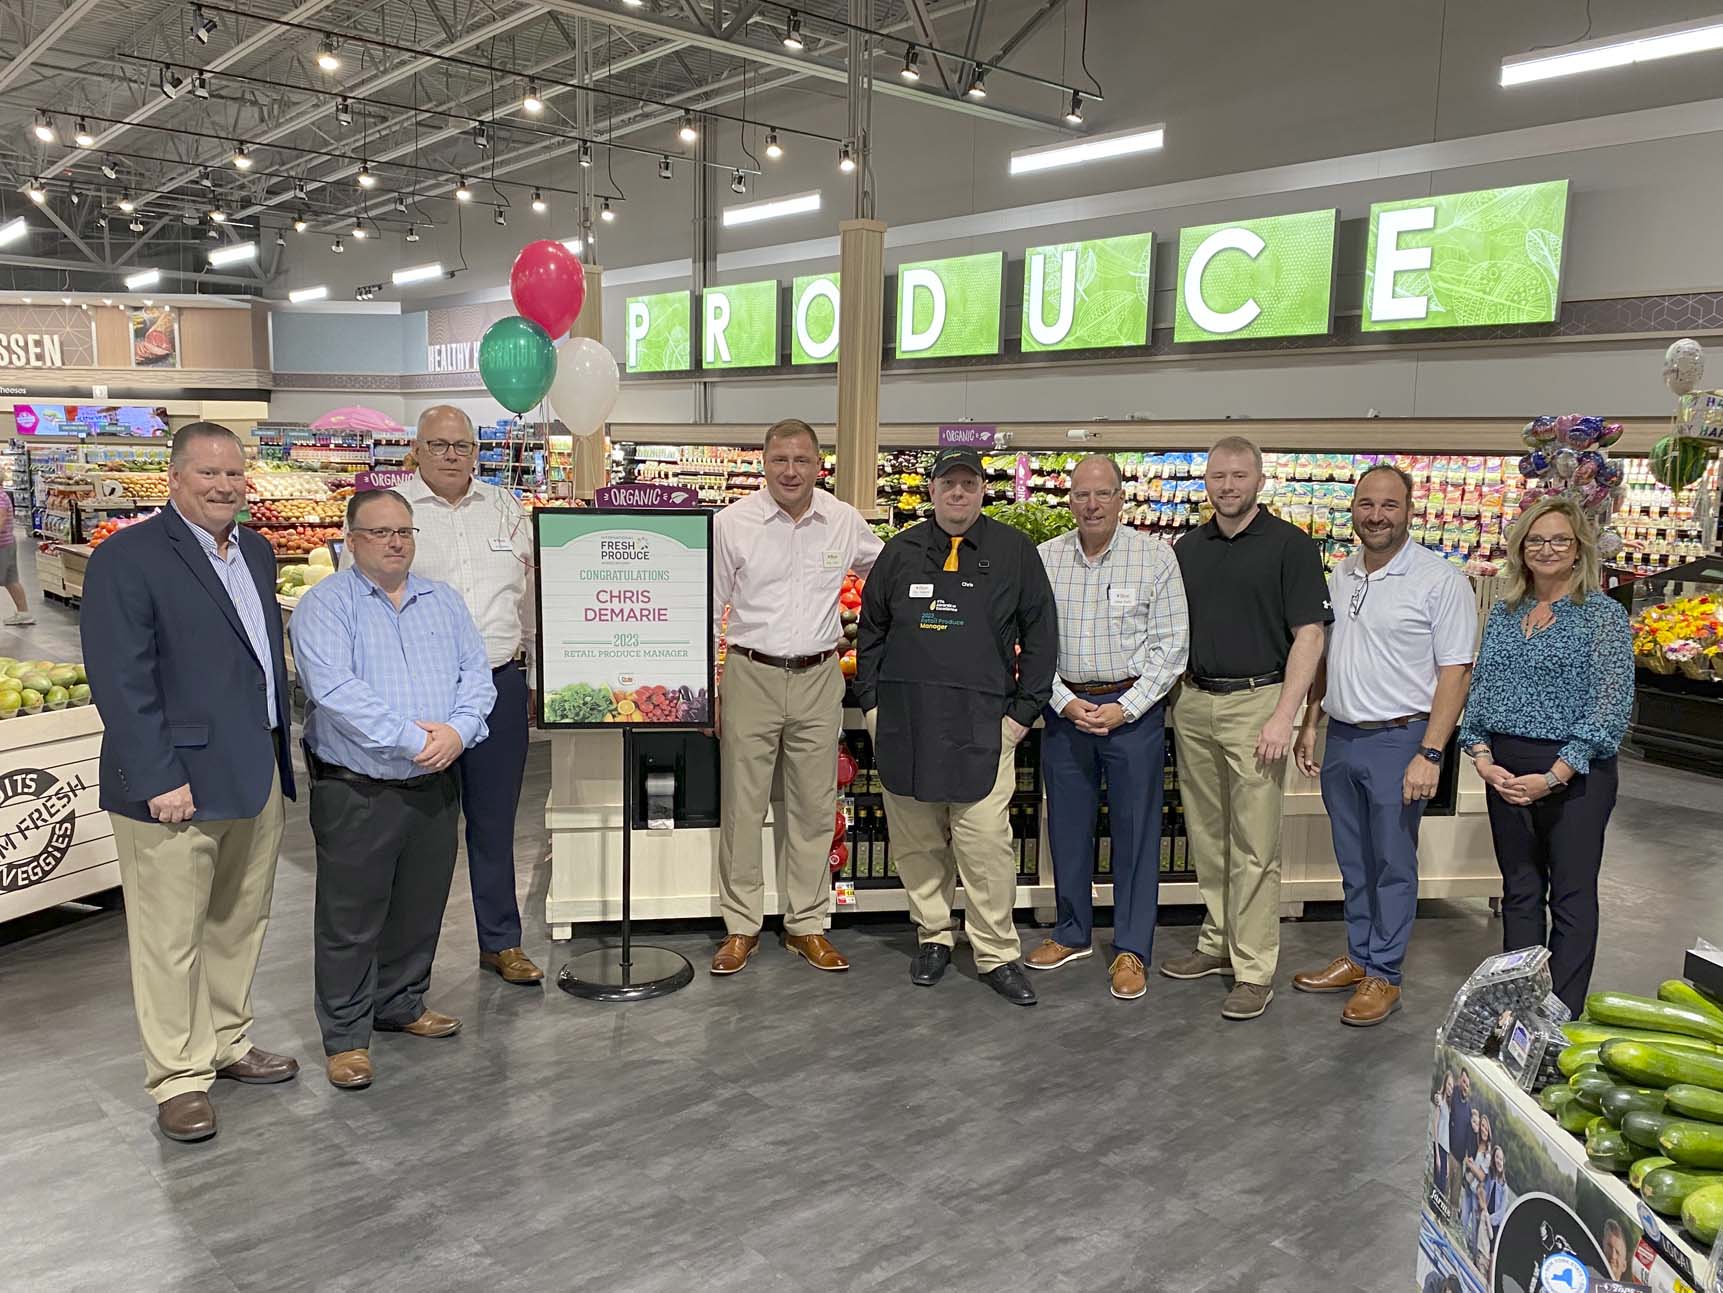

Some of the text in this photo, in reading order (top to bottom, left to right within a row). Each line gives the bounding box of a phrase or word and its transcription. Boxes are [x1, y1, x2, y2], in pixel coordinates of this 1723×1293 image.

[627, 206, 1436, 367] PRODUCE
[428, 342, 471, 372] HEALTHY
[946, 430, 975, 442] ORGANIC
[610, 488, 661, 506] ORGANIC
[601, 541, 635, 550] FRESH
[601, 551, 650, 560] PRODUCE
[579, 569, 670, 581] CONGRATULATIONS
[596, 589, 651, 604] CHRIS
[584, 607, 668, 622] DEMARIE
[920, 623, 948, 631] Manager
[939, 618, 964, 626] Produce
[613, 633, 640, 647] 2023
[564, 650, 689, 658] RETAIL PRODUCE MANAGER
[16, 774, 86, 841] FRESH
[2, 822, 71, 886] VEGGIES
